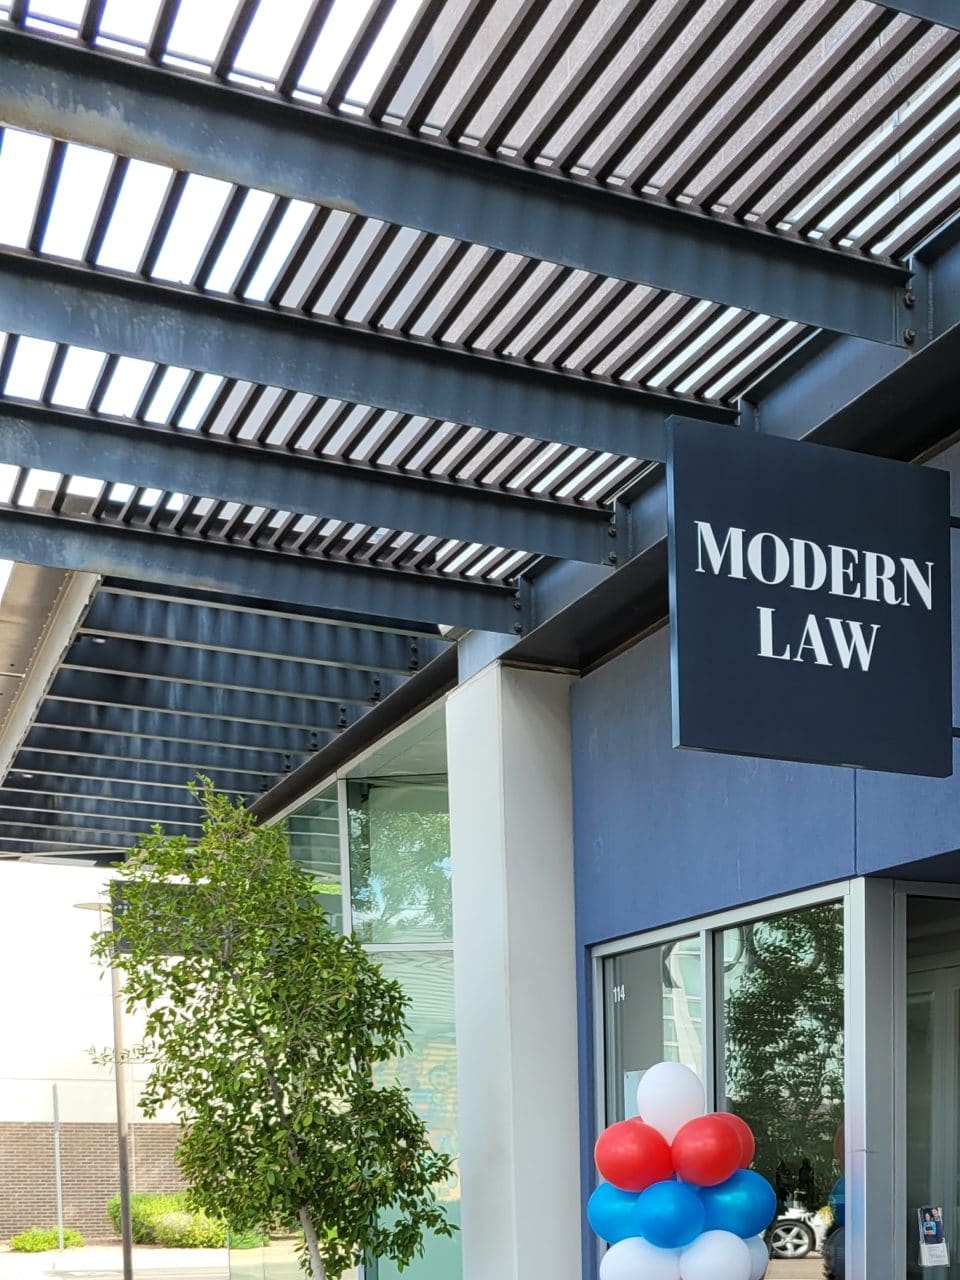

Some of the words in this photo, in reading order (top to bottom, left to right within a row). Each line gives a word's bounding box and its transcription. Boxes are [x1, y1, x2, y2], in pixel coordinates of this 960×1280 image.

[694, 521, 934, 610] MODERN
[756, 606, 881, 672] LAW
[612, 984, 626, 1003] 114
